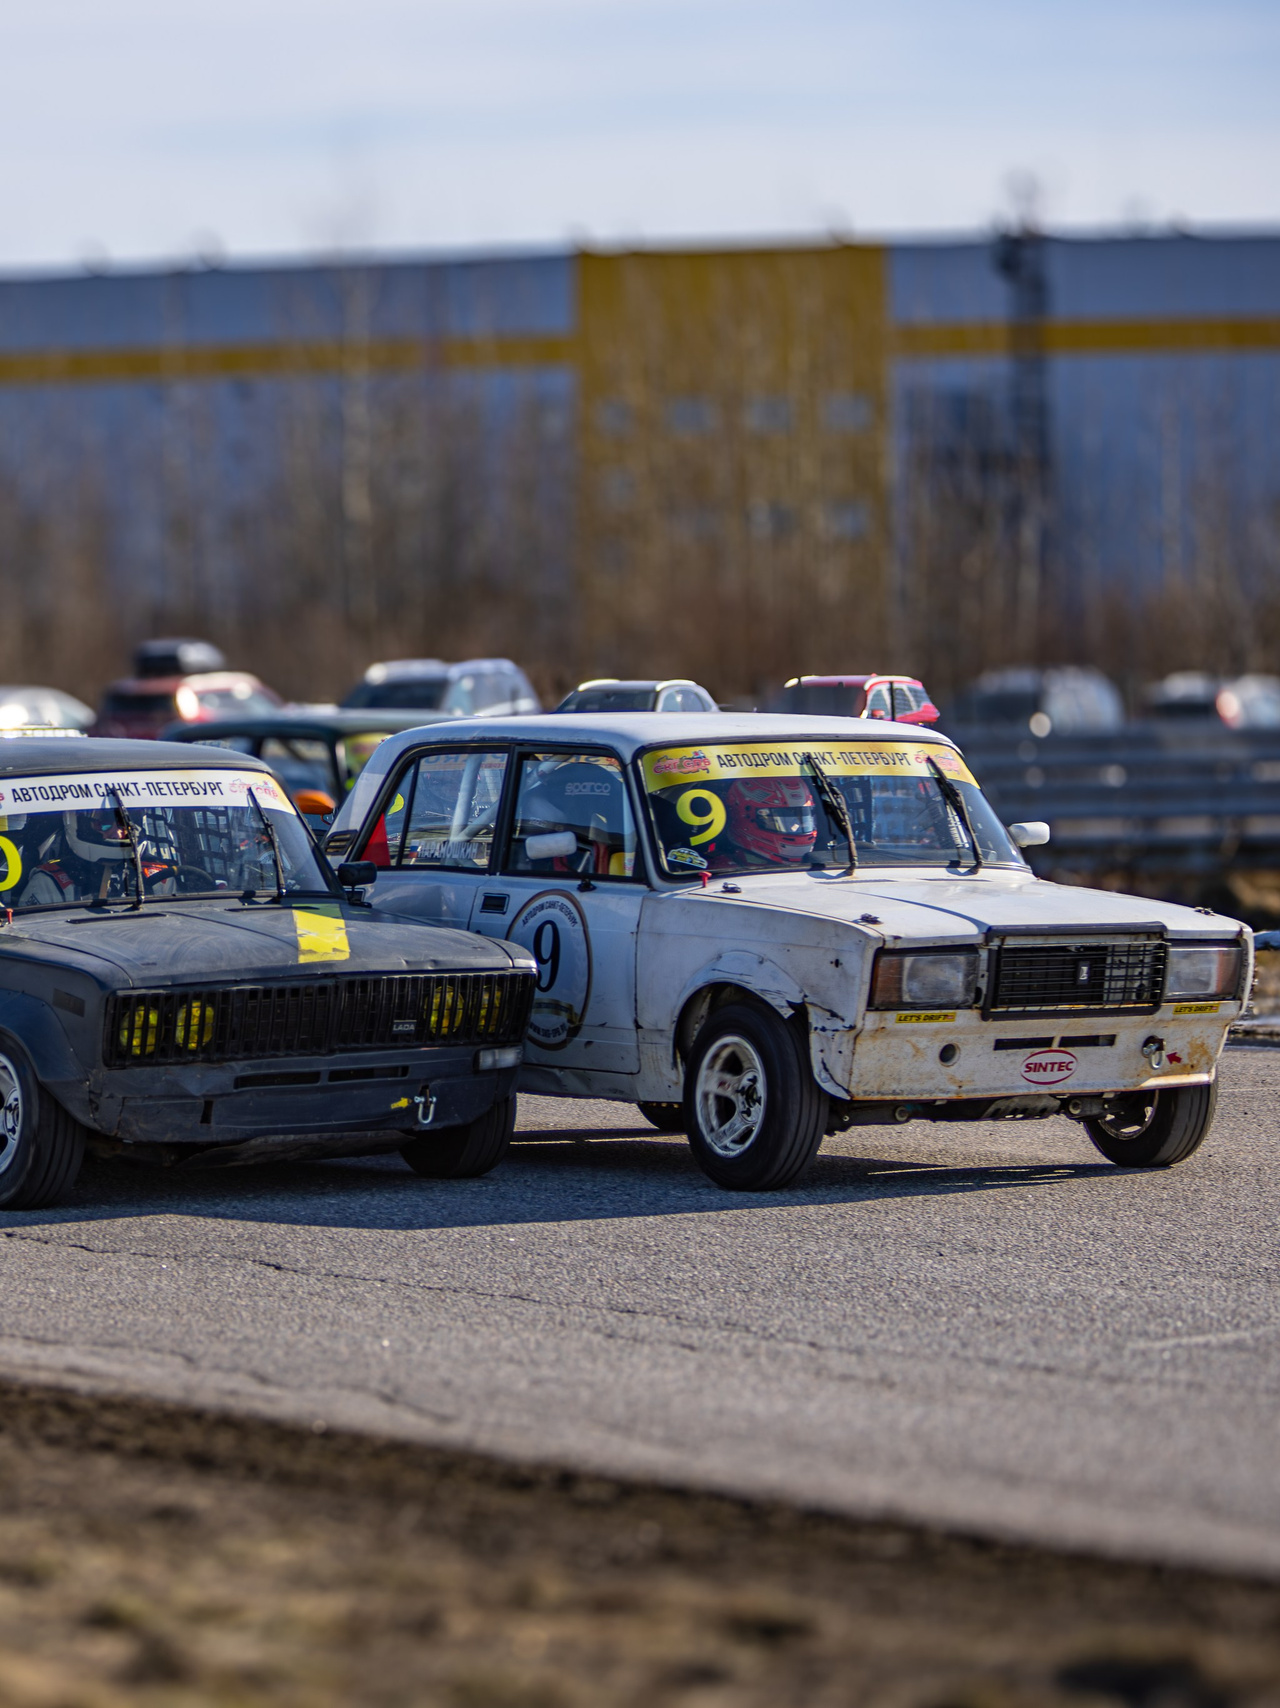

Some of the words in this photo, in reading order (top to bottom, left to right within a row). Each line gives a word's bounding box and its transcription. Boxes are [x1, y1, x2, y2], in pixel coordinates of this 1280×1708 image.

[653, 760, 679, 774] СКГ
[685, 757, 712, 769] СПБ
[716, 752, 794, 769] АВТОДРОМ
[11, 783, 94, 803] АВТОДРОМ
[94, 781, 225, 799] САНКТ-ПЕТЕРБУРГ
[565, 782, 611, 796] sparco
[676, 788, 727, 847] 9
[418, 841, 479, 859] ПАРАМОШКИН
[533, 919, 560, 993] 9
[392, 1023, 416, 1031] LADA
[1024, 1061, 1074, 1073] SINTEC
